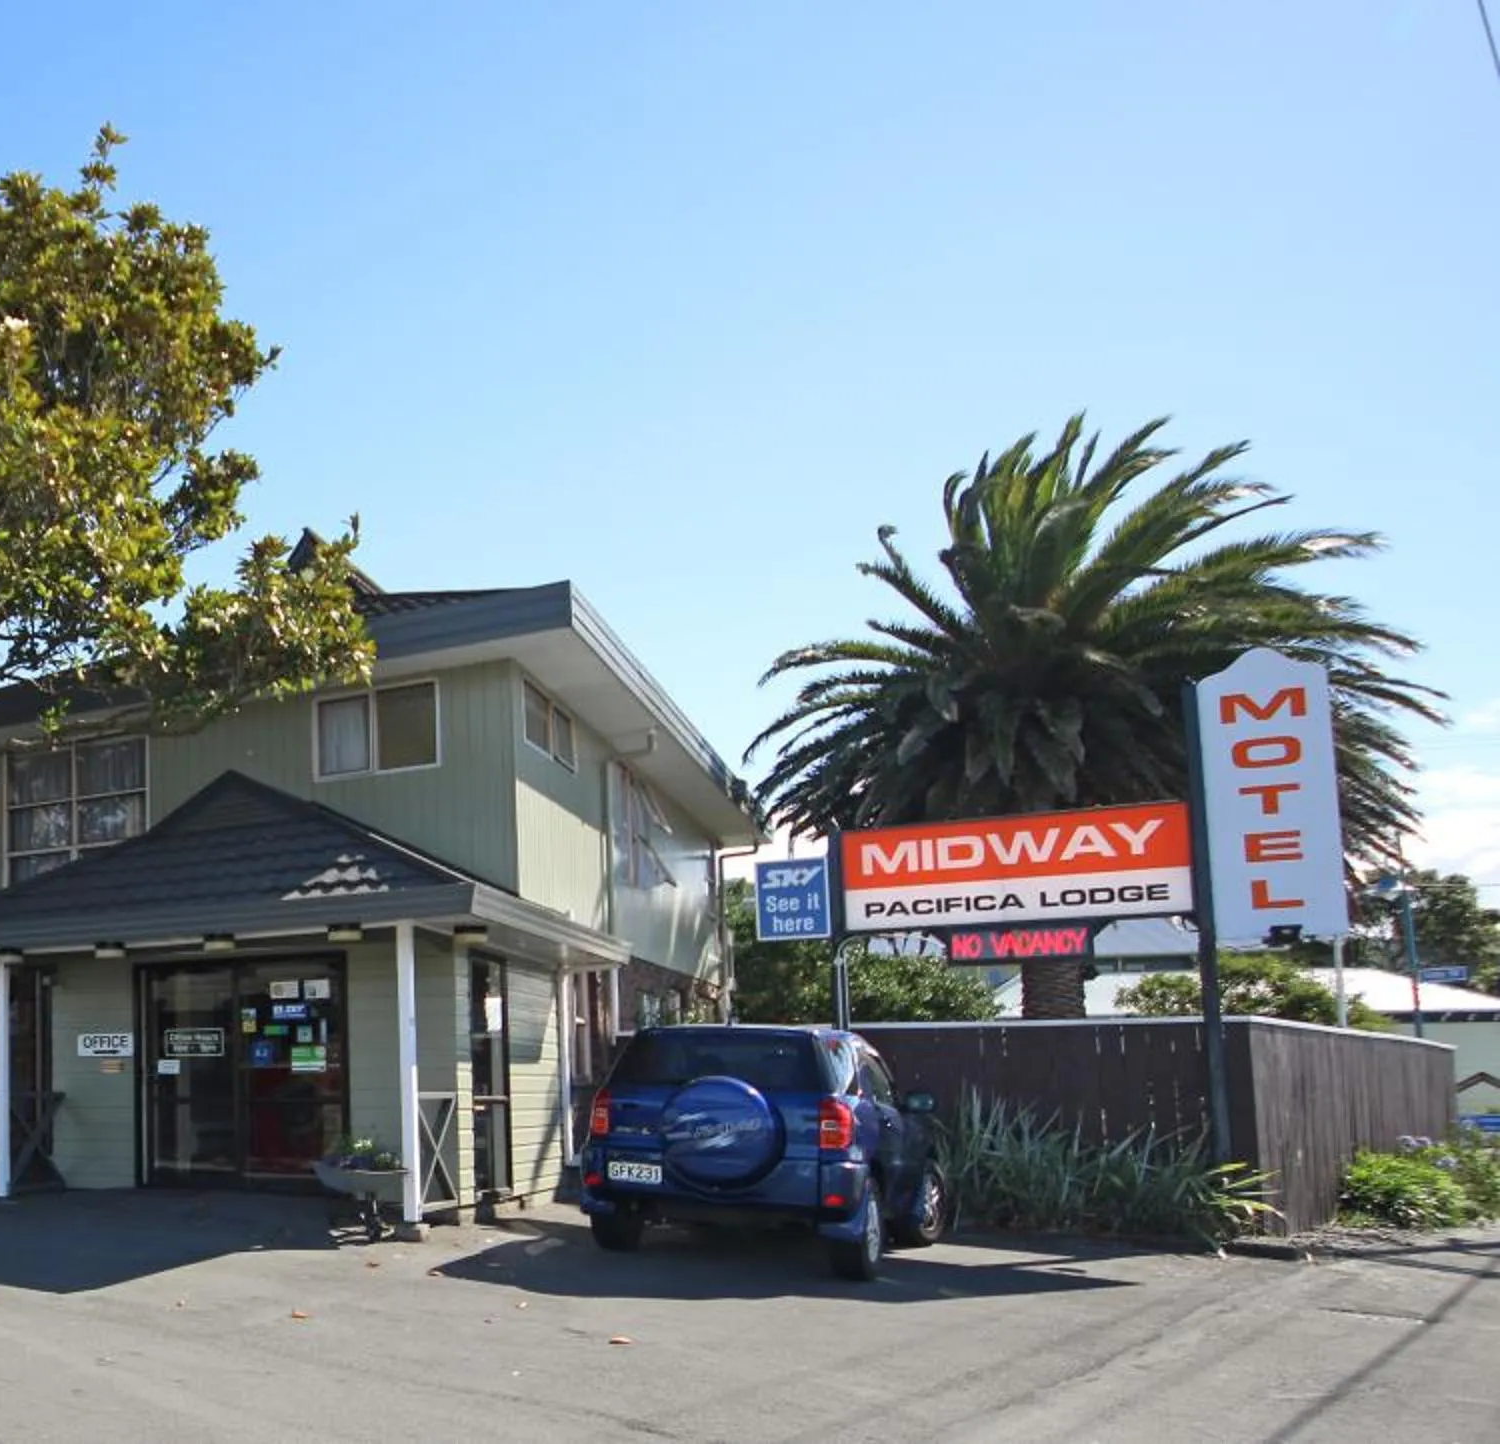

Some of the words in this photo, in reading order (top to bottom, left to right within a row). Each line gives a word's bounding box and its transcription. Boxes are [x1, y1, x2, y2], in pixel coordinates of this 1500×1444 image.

[1220, 687, 1306, 910] MOTEL
[861, 819, 1163, 876] MIDWAY
[762, 866, 823, 889] SKY
[765, 895, 801, 913] See
[807, 892, 820, 911] it
[864, 893, 1025, 918] PACIFICA
[1039, 884, 1170, 908] LODGE
[772, 915, 815, 933] here
[951, 931, 981, 958] NO
[989, 927, 1089, 956] VACANCY
[83, 1035, 129, 1049] OFFICE
[611, 1161, 661, 1183] GFK231
